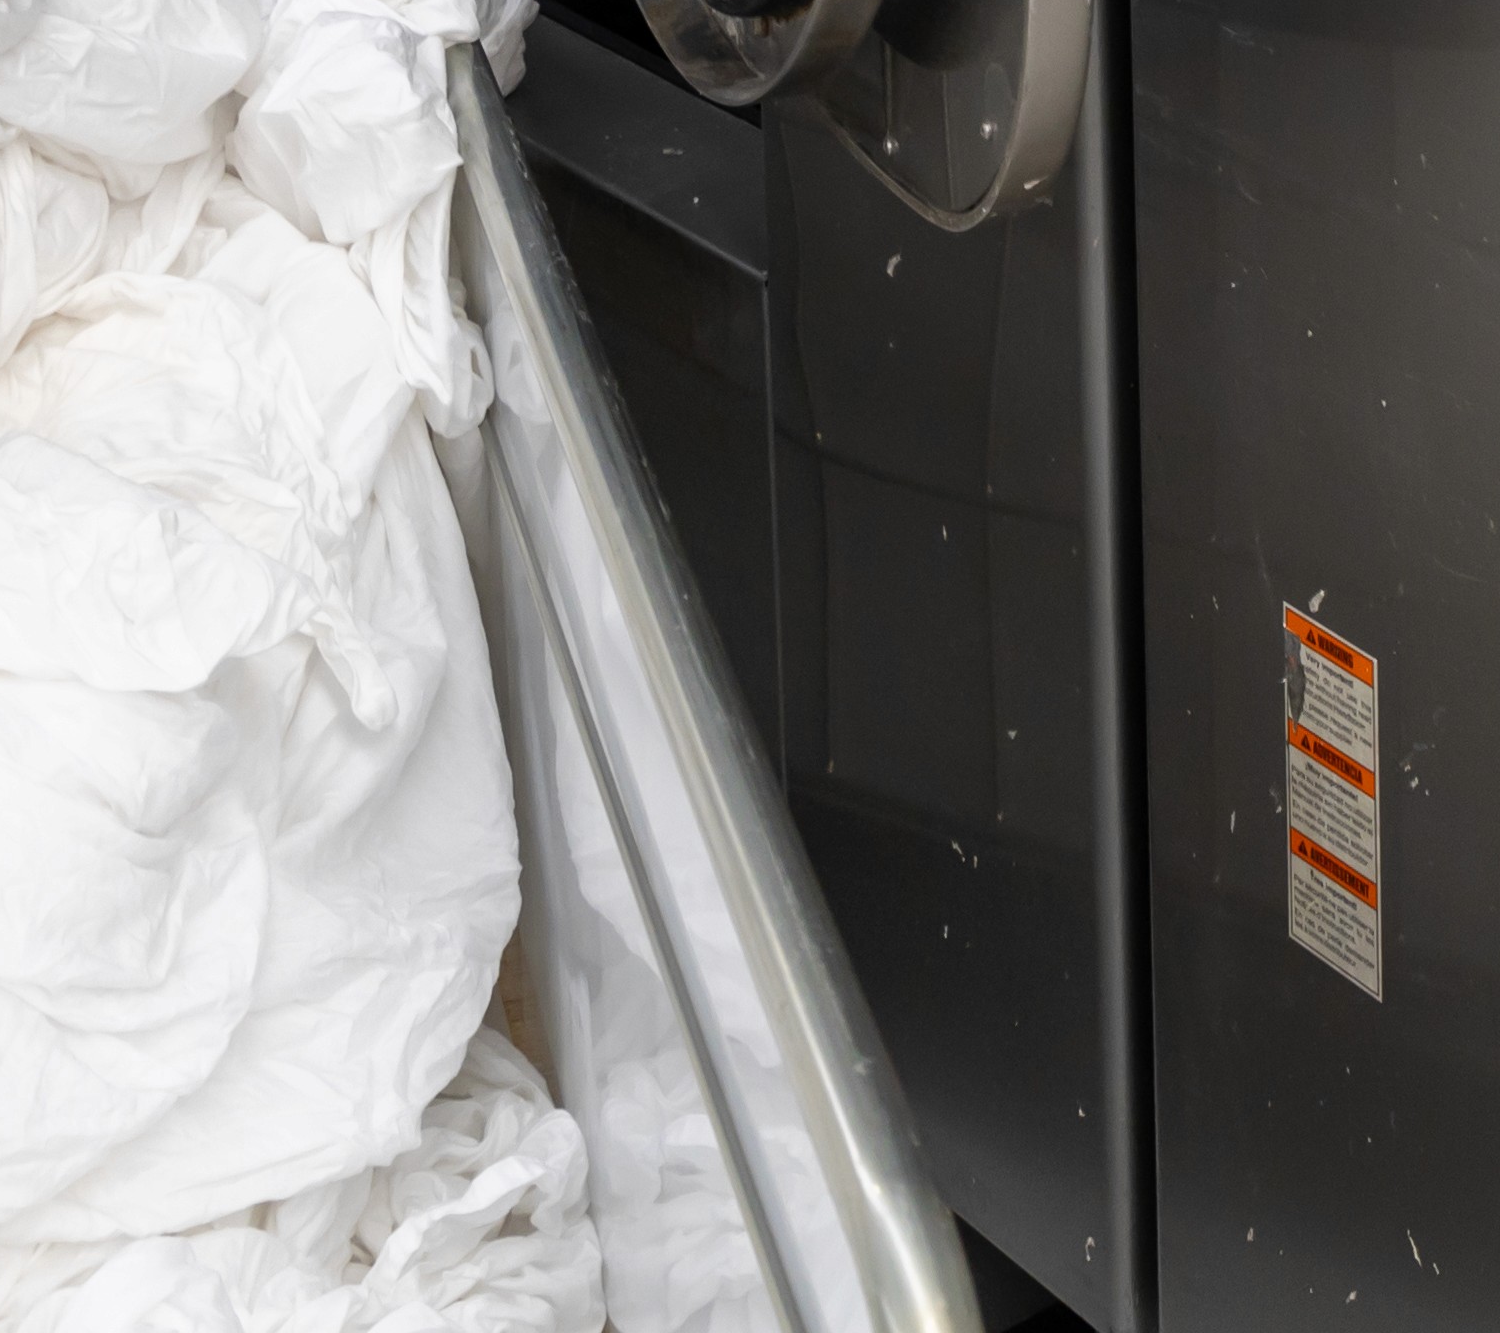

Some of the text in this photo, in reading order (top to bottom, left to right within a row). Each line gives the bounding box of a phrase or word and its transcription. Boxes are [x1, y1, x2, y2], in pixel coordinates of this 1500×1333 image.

[1318, 633, 1353, 669] WARNING
[1312, 739, 1362, 785] ADVERTENCIA
[1310, 845, 1369, 899] AVERTISSEMENT
